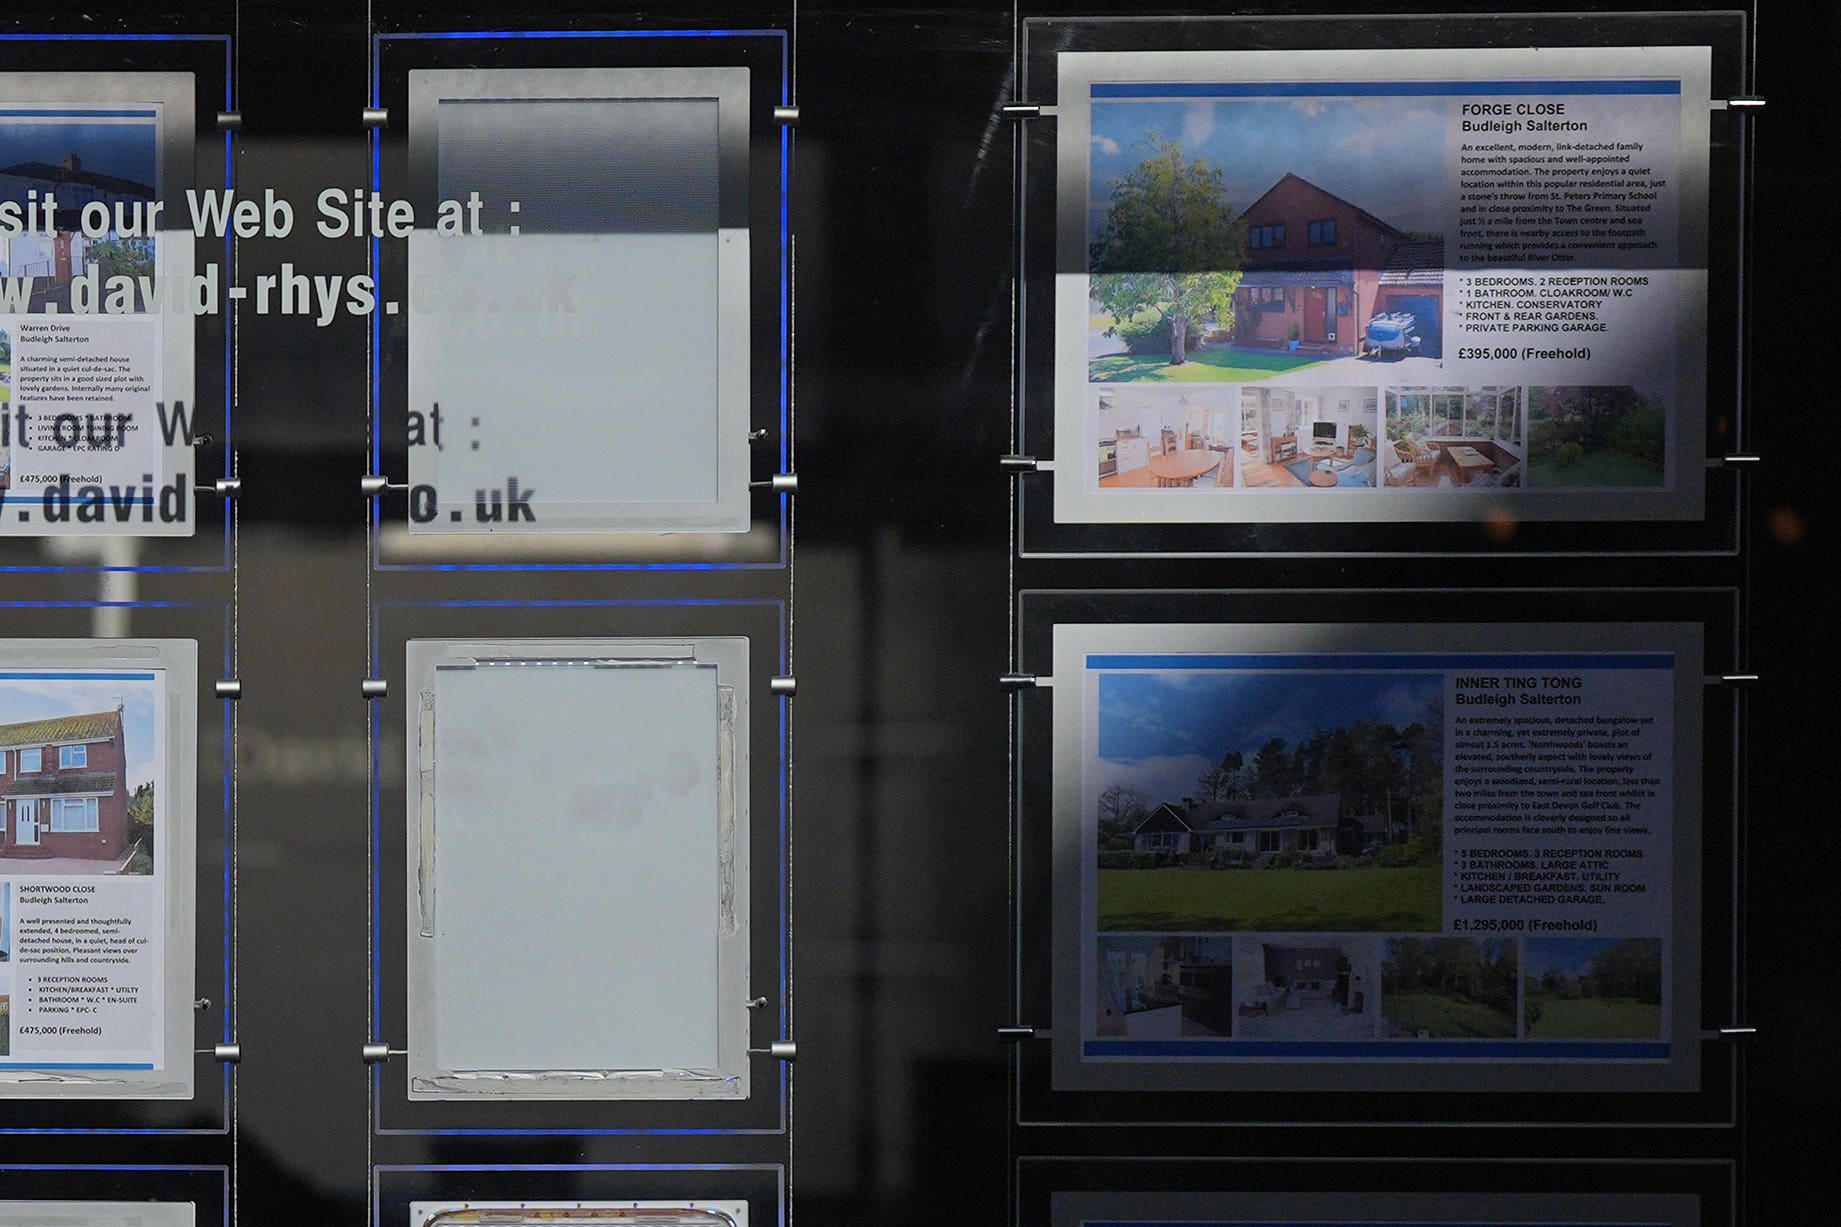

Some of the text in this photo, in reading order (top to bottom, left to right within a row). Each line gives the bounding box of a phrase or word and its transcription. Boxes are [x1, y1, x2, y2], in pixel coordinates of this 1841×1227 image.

[1462, 103, 1565, 116] FORGE CLOSE
[1462, 119, 1588, 135] Budleigh Salterton
[80, 199, 164, 238] our
[185, 188, 294, 238] Web
[316, 188, 415, 238] Site
[436, 191, 484, 238] at
[1466, 277, 1472, 287] 3
[1539, 277, 1546, 286] 2
[1548, 276, 1608, 286] RECEPTION
[1610, 276, 1649, 286] ROOMS
[1465, 311, 1501, 321] FRONT
[1503, 312, 1511, 321] &
[1513, 311, 1543, 321] REAR
[1458, 347, 1591, 361] £395,000 (Freehold)
